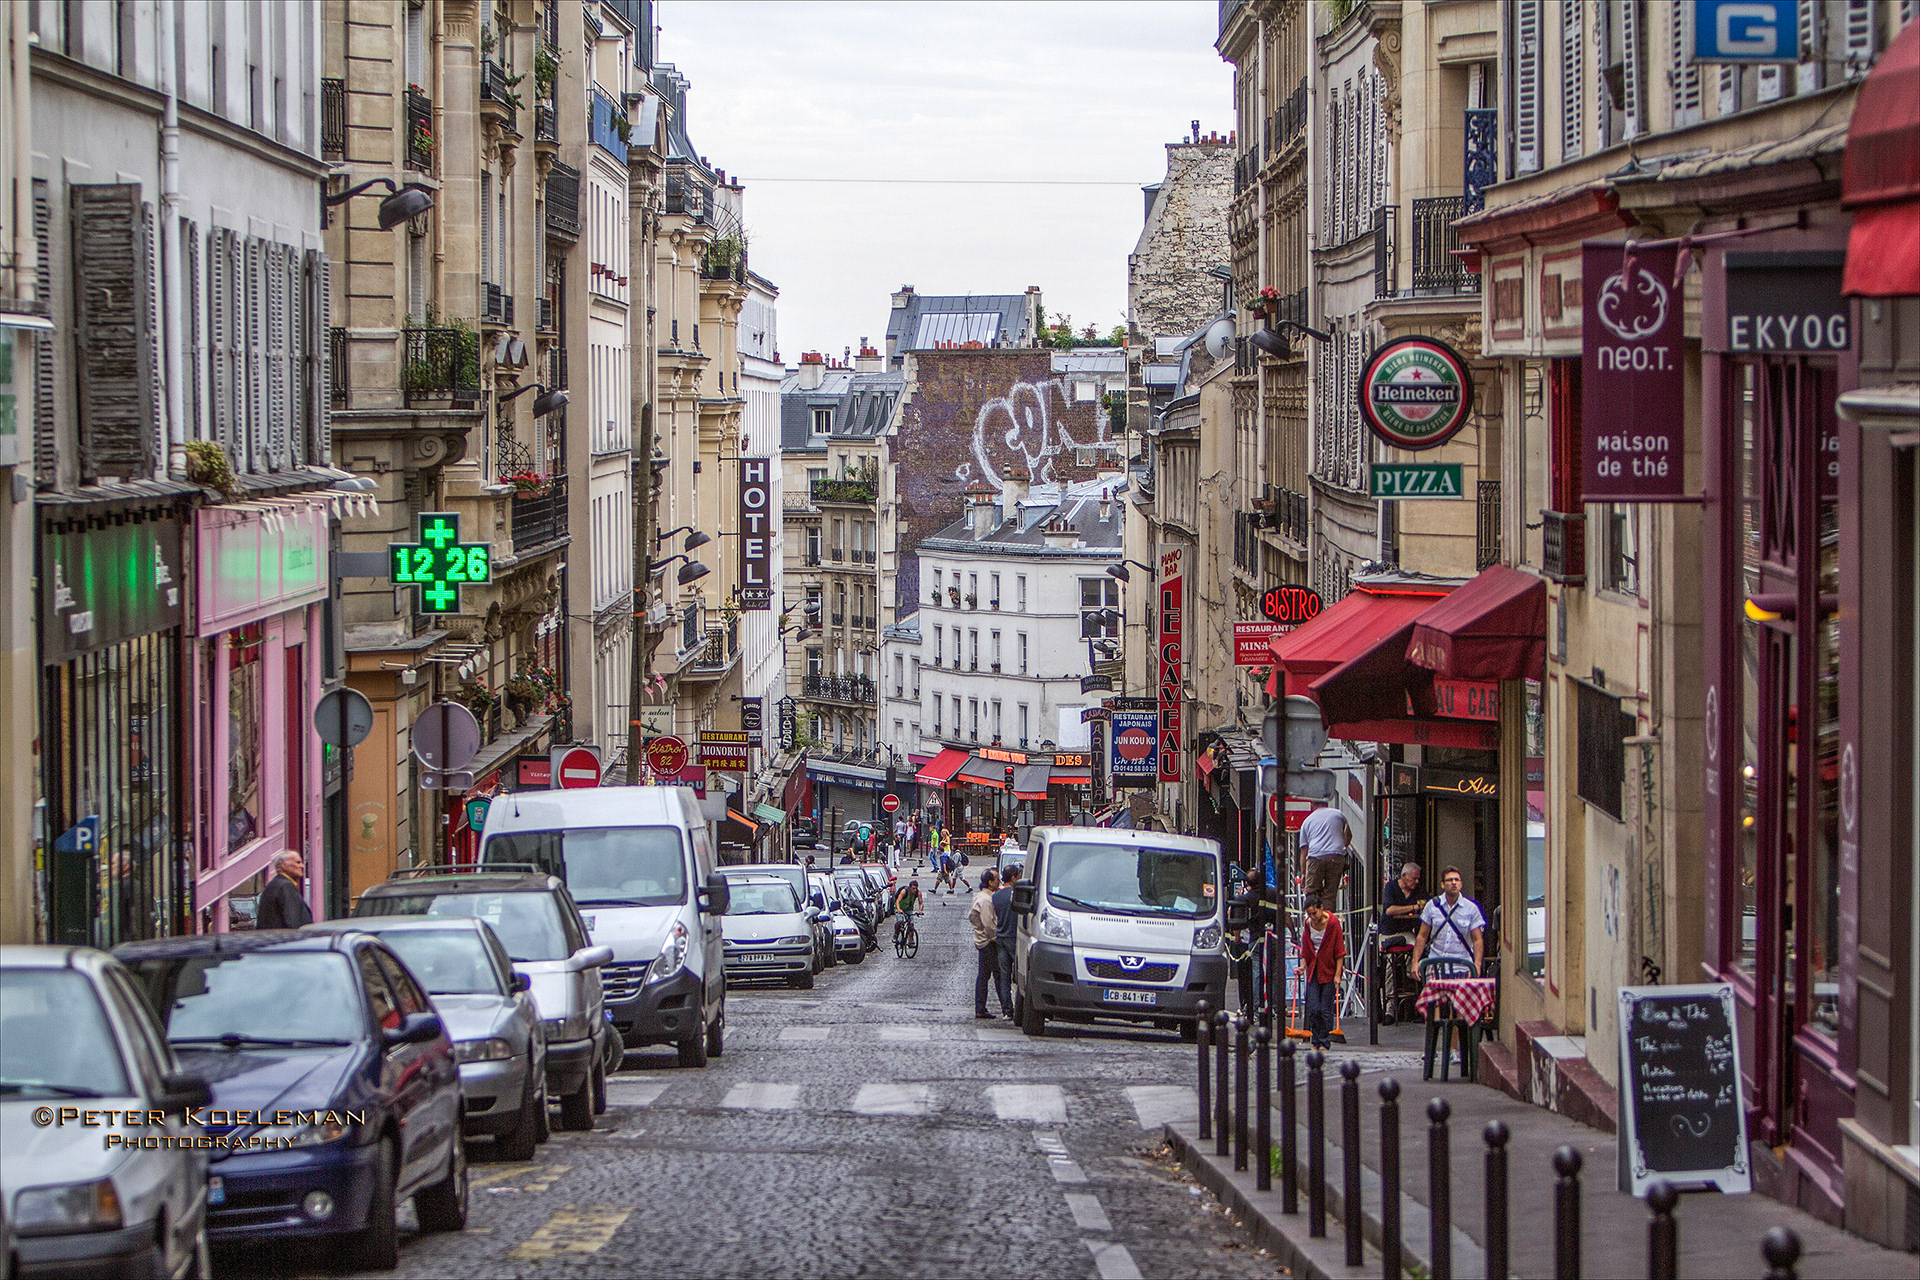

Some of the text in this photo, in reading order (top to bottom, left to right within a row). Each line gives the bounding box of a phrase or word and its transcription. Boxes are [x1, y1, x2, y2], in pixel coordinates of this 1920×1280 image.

[1731, 314, 1847, 349] EKYOG
[1408, 353, 1447, 374] HEINEKEN
[1377, 385, 1455, 401] Heineken
[1597, 456, 1668, 476] de thé
[1375, 470, 1456, 494] PIZZA
[743, 462, 766, 584] HOTEL
[396, 547, 487, 581] 12 26
[1161, 548, 1182, 567] PIANO
[1164, 562, 1178, 577] BAR
[1265, 588, 1319, 621] BISTRO
[1236, 625, 1290, 633] RESTAURANT
[1240, 641, 1269, 651] MINA
[1161, 590, 1180, 775] LE CAVEAU
[1114, 713, 1157, 721] RESTAURANT
[702, 733, 748, 741] RESTAURANT
[1114, 736, 1156, 745] JUN KOU KO
[702, 746, 747, 756] MONORUM
[659, 755, 673, 766] 82
[1055, 755, 1082, 766] DES
